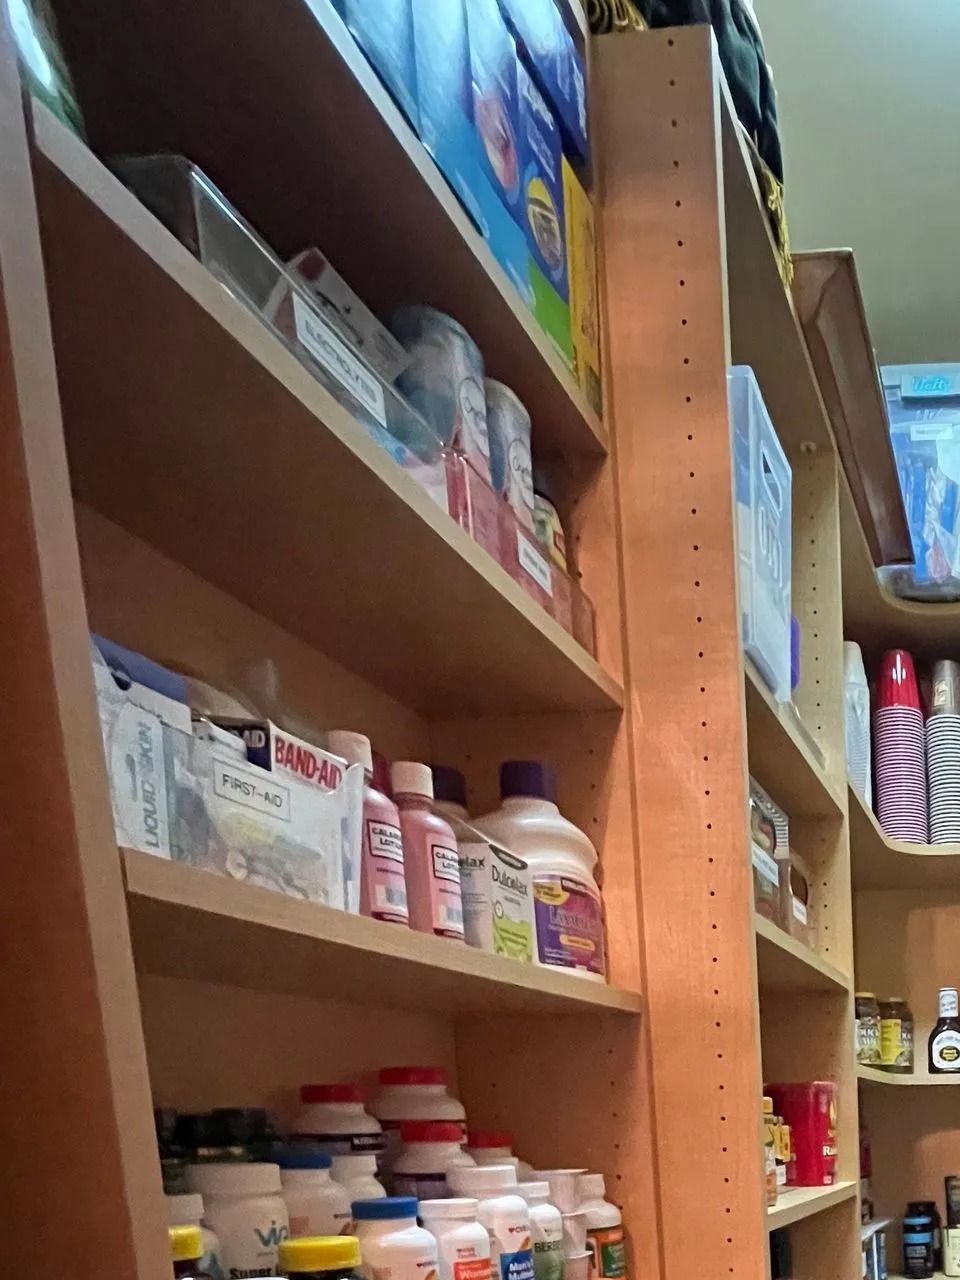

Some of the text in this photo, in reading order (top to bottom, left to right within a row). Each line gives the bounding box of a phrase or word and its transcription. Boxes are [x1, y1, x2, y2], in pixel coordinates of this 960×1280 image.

[137, 720, 160, 849] LIQUID SKIN
[222, 772, 284, 808] FIRST-AID
[274, 734, 343, 791] BAND-AID
